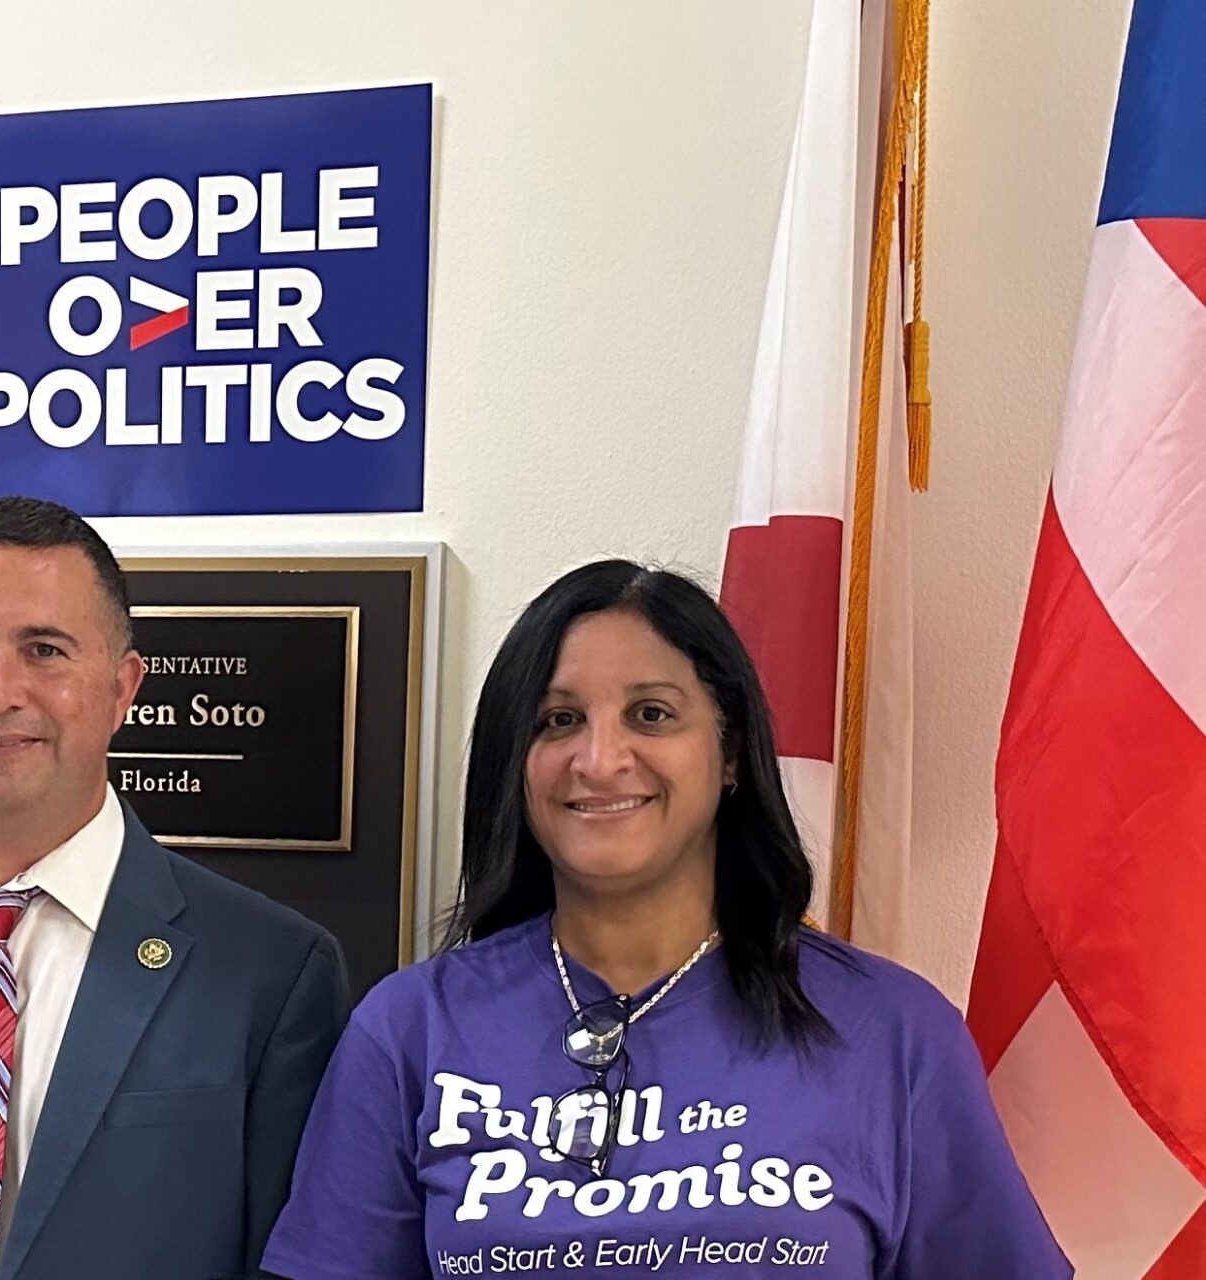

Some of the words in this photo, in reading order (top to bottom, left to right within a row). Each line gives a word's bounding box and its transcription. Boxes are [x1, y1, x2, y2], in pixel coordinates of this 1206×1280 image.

[0, 165, 379, 266] PEOPLE
[141, 656, 248, 675] SENTATIVE
[123, 703, 177, 726] ren
[189, 693, 266, 728] Soto
[120, 768, 202, 792] Florida
[428, 1071, 665, 1163] Fulfill
[678, 1100, 748, 1135] the
[455, 1142, 835, 1222] Promise
[438, 1248, 484, 1276] Head
[489, 1242, 557, 1273] Start
[562, 1241, 585, 1268] &
[595, 1237, 674, 1271] Early
[678, 1236, 768, 1266] Head
[770, 1236, 831, 1266] Start
